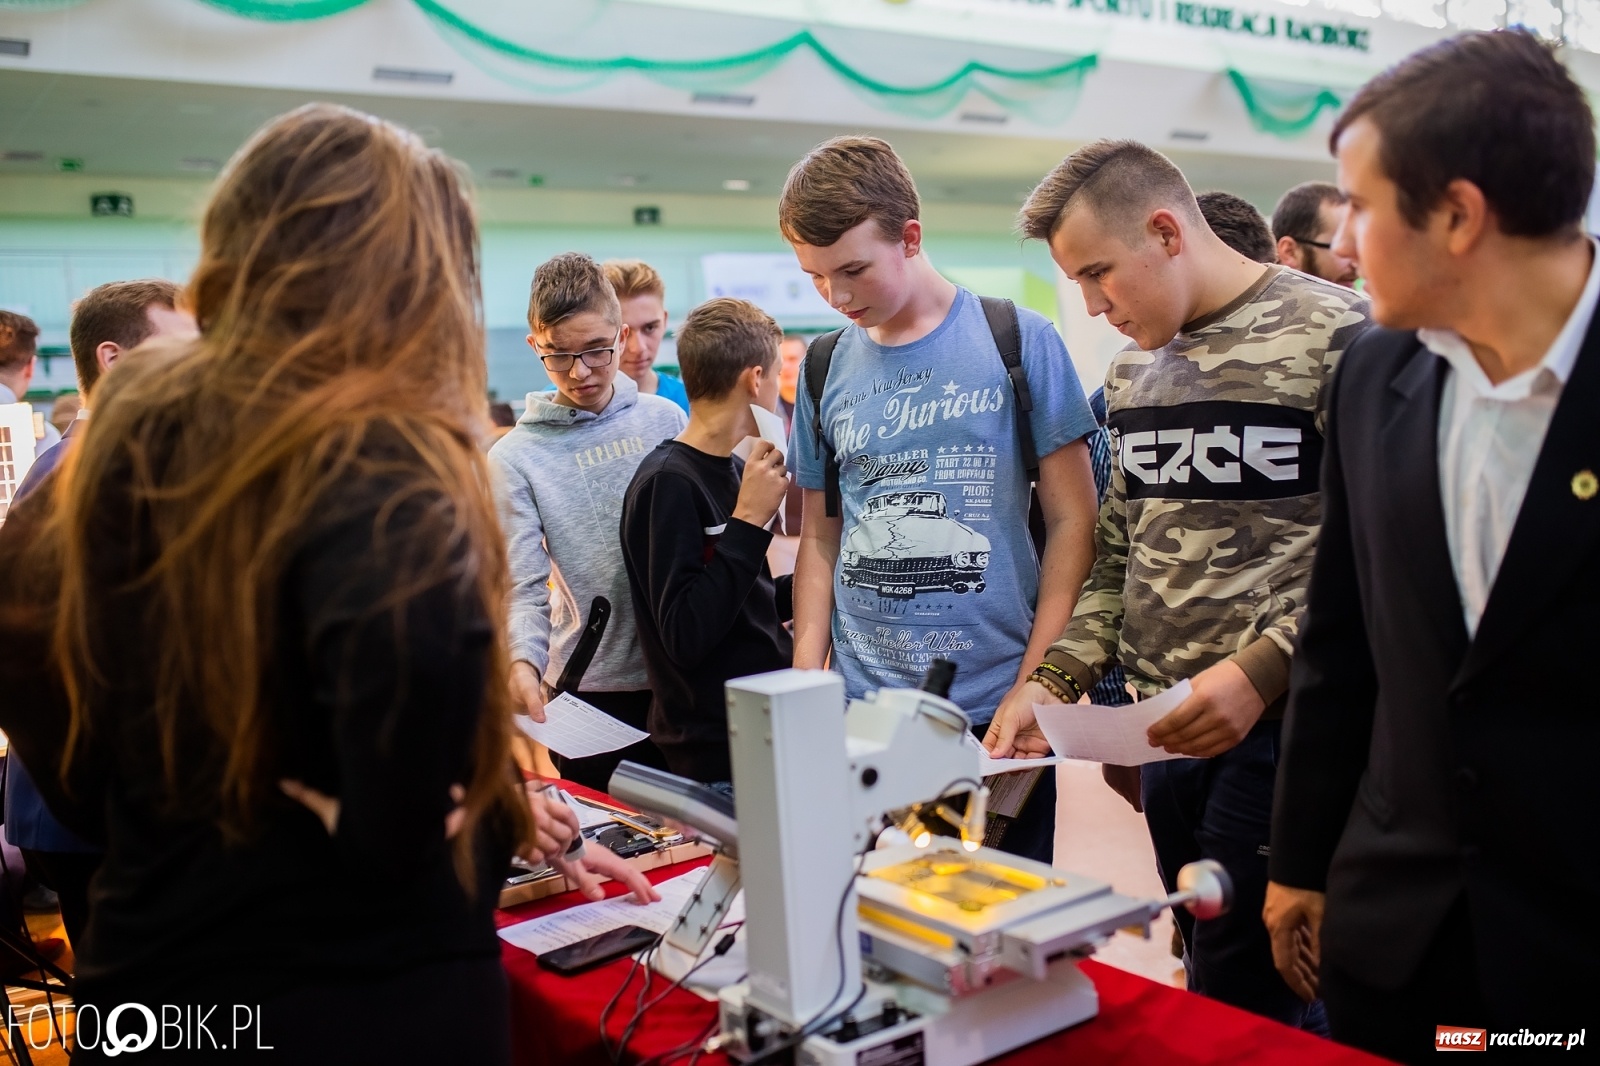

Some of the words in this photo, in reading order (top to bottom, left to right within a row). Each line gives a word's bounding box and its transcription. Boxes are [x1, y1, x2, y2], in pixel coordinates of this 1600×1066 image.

[894, 365, 934, 390] Jersey
[575, 436, 644, 469] EXPLORER
[880, 448, 929, 464] KELLER
[860, 459, 931, 484] Danny
[935, 458, 959, 469] START
[934, 469, 955, 480] FROM
[878, 598, 909, 615] 1977
[922, 630, 974, 651] Wins
[877, 646, 898, 660] CITY
[909, 664, 931, 672] BRAN
